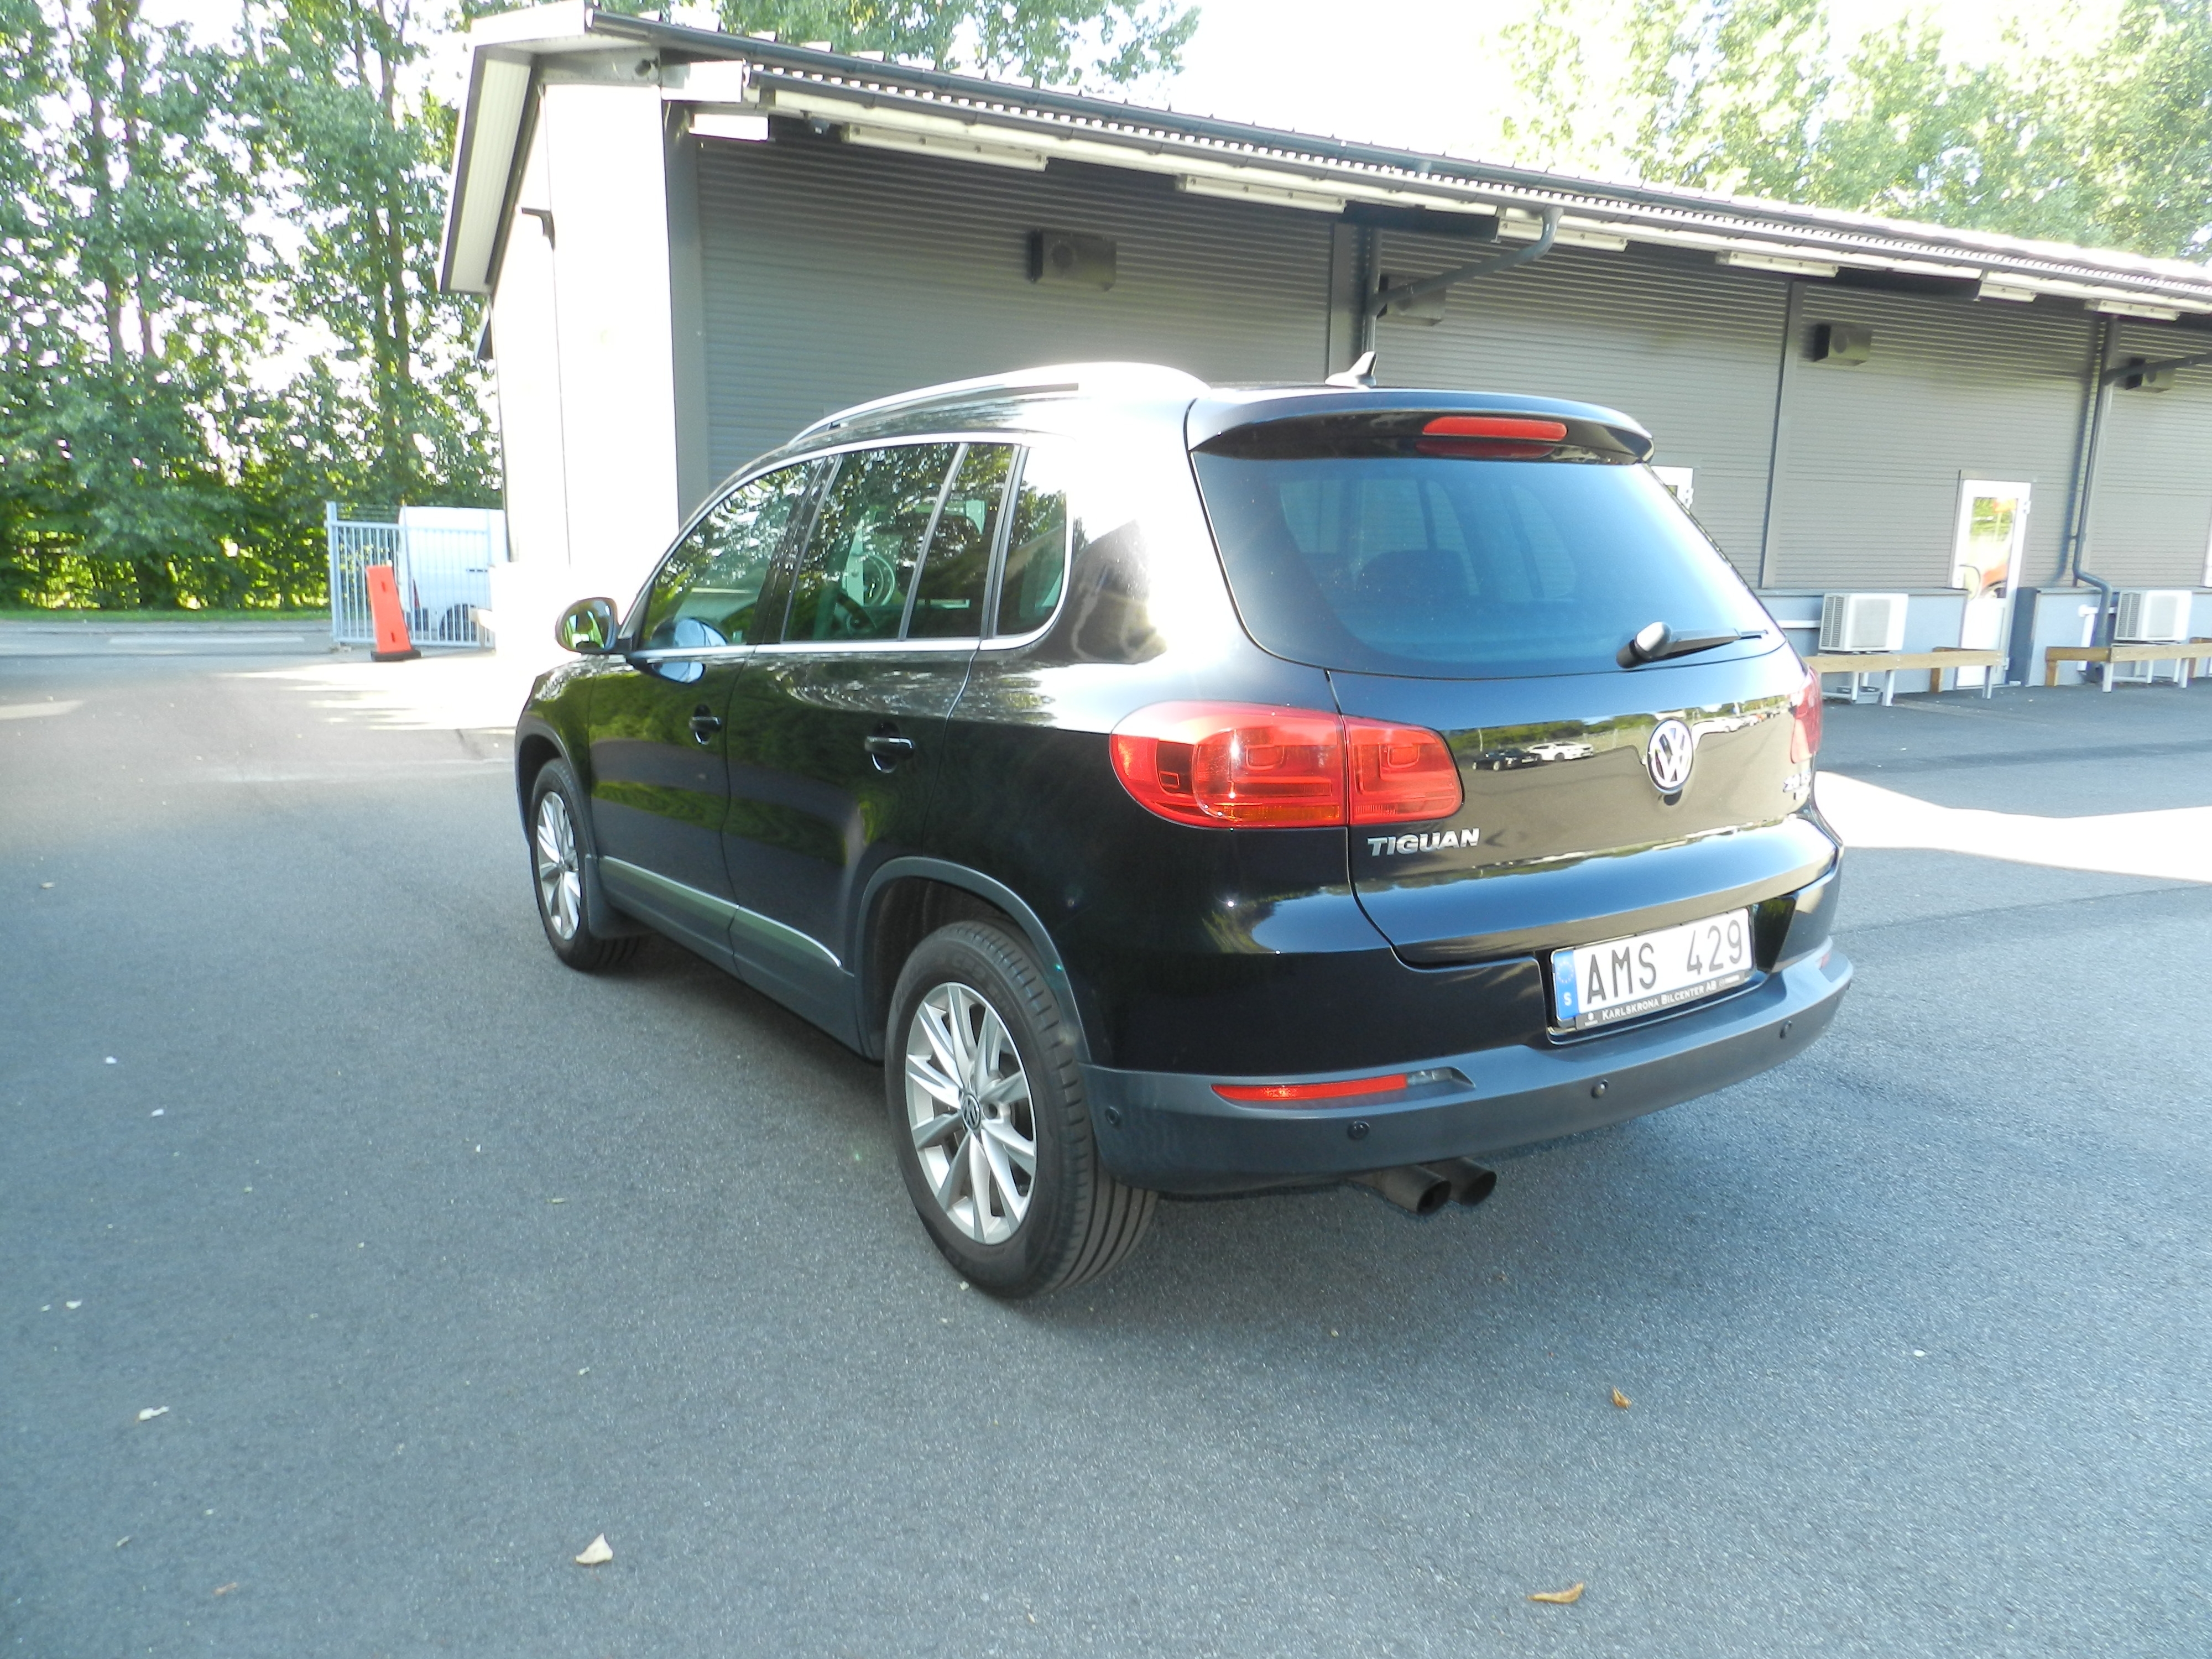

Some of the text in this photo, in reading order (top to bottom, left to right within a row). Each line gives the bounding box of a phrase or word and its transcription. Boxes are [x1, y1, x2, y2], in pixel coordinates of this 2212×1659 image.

[1367, 827, 1480, 857] TIGUAN
[1587, 920, 1743, 1005] AMS 429
[1563, 992, 1573, 1006] S
[1601, 980, 1717, 1021] KARLSKRONA BILCENTER AB
